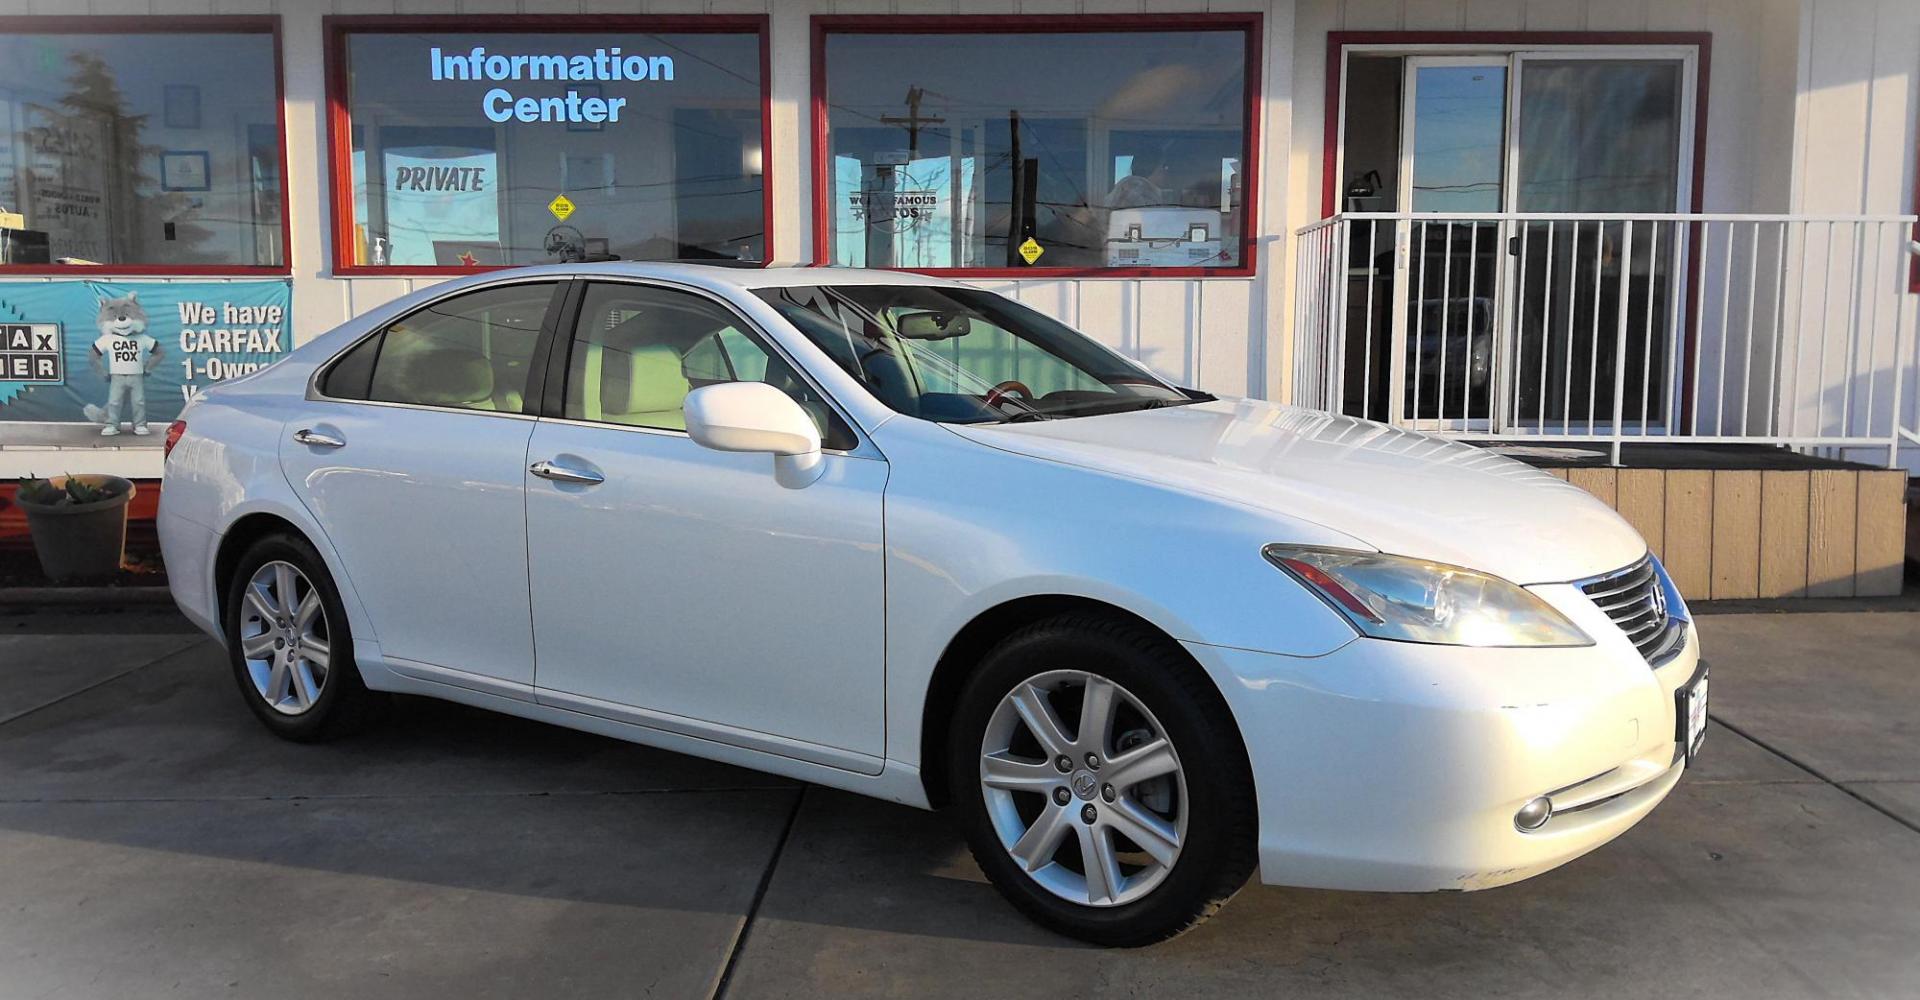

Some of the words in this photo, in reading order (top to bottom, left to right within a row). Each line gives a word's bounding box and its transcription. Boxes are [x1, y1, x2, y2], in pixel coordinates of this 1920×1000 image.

[431, 47, 674, 81] Information
[482, 88, 626, 122] Center
[395, 166, 485, 192] PRIVATE
[893, 196, 937, 205] FAMOUS
[178, 302, 215, 324] We
[223, 301, 282, 324] have
[0, 329, 53, 351] AX
[112, 340, 138, 351] CAR
[179, 328, 282, 353] CARFAX
[0, 358, 54, 376] ER
[115, 351, 138, 363] FOX
